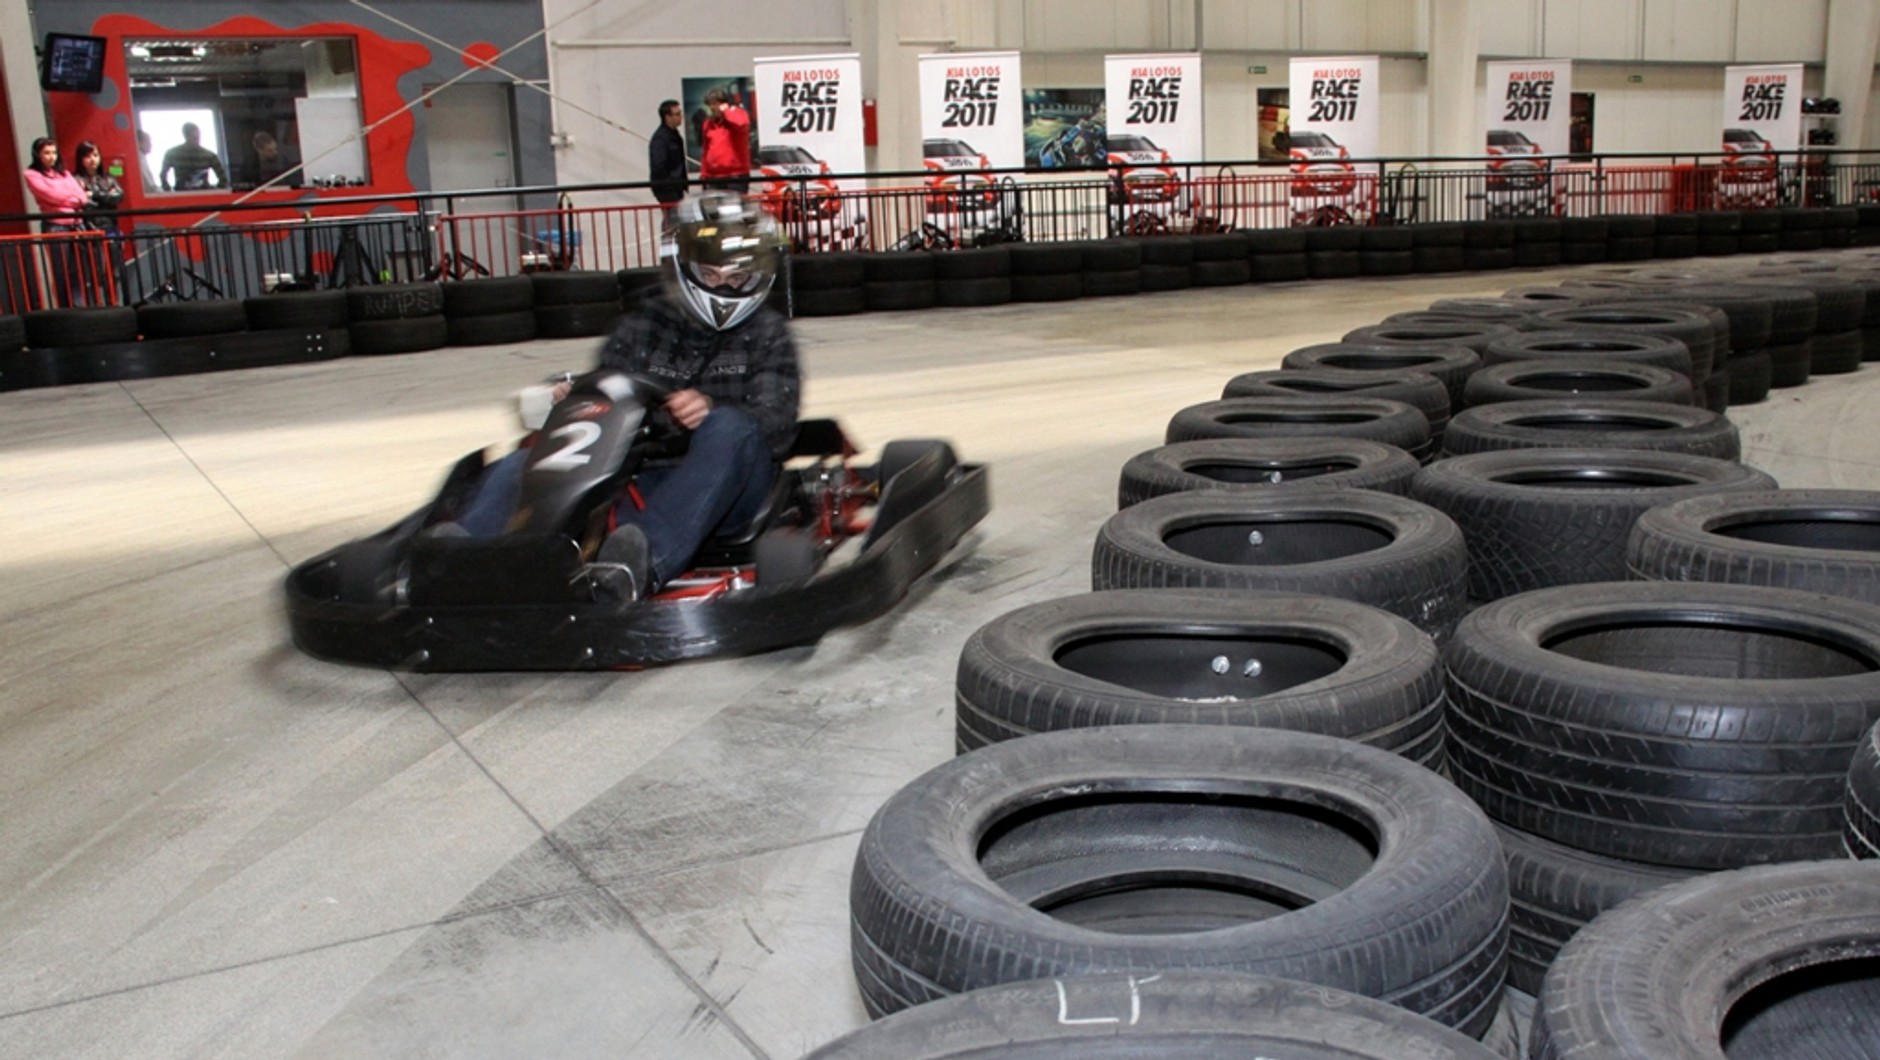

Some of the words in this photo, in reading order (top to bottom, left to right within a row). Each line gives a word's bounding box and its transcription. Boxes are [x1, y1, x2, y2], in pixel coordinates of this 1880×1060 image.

[784, 71, 801, 81] KIA
[803, 69, 840, 81] LOTOS
[946, 68, 963, 78] KIA
[966, 66, 1001, 77] LOTOS
[1131, 68, 1148, 77] KIA
[1149, 66, 1182, 77] LOTOS
[1331, 68, 1362, 78] LOTOS
[781, 81, 839, 107] RACE
[944, 77, 1000, 102] RACE
[1129, 77, 1182, 100] RACE
[1311, 79, 1361, 100] RACE
[1506, 81, 1554, 100] RACE
[1742, 84, 1786, 101] RACE
[779, 107, 836, 133] 2011
[942, 102, 997, 127] 2011
[1126, 101, 1178, 124] 2011
[1308, 100, 1357, 122] 2011
[1503, 101, 1550, 121] 2011
[1739, 102, 1782, 120] 2011
[534, 421, 602, 471] 2
